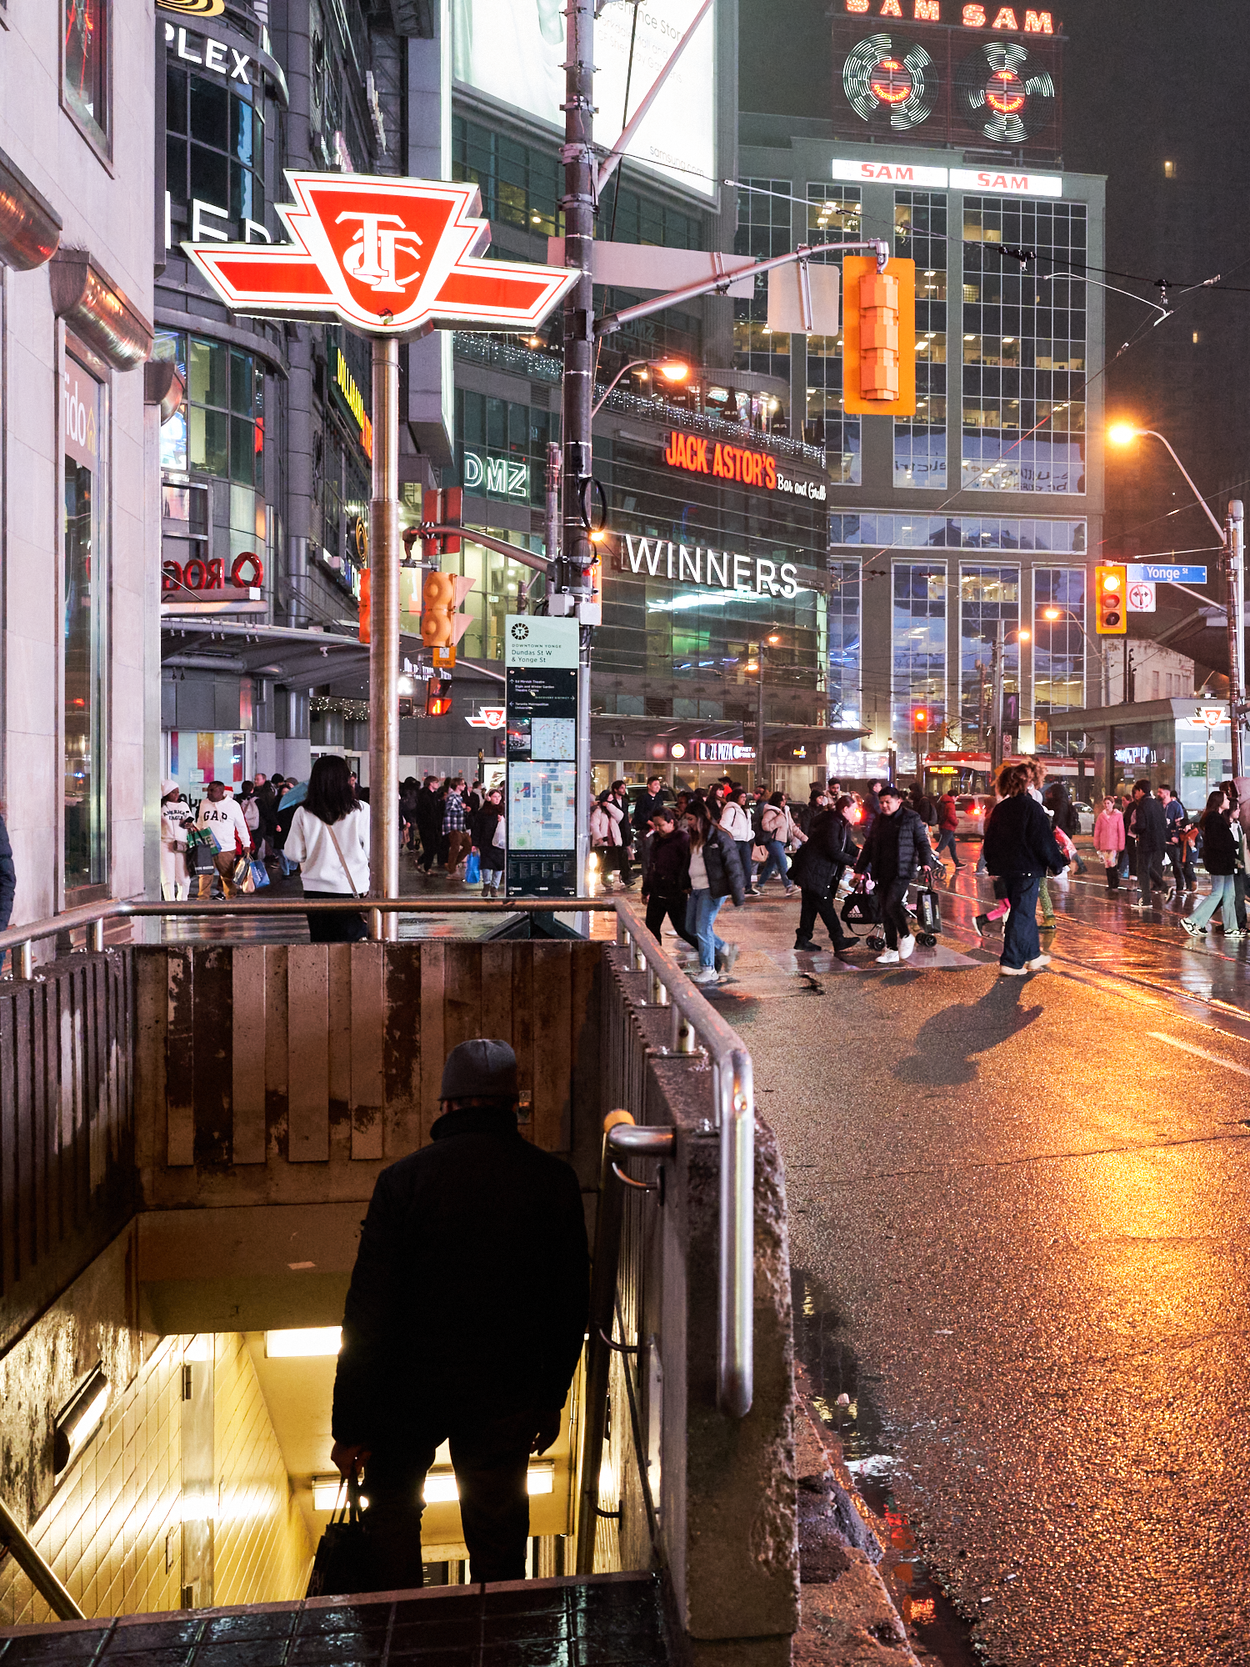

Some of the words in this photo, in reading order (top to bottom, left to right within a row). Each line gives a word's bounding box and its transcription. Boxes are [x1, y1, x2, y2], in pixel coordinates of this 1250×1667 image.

[846, 0, 940, 21] SAM
[962, 4, 1054, 34] SAM
[861, 163, 914, 181] SAM
[977, 172, 1029, 190] SAM
[65, 371, 87, 447] ido
[464, 451, 526, 496] DMZ
[665, 431, 709, 474] JACK
[712, 443, 777, 490] ASTOR'S
[777, 473, 793, 492] Bar
[795, 481, 807, 496] and
[625, 533, 799, 600] WINNERS
[1147, 566, 1180, 581] Yonge
[518, 656, 538, 664] Yonge
[203, 810, 228, 821] GAP
